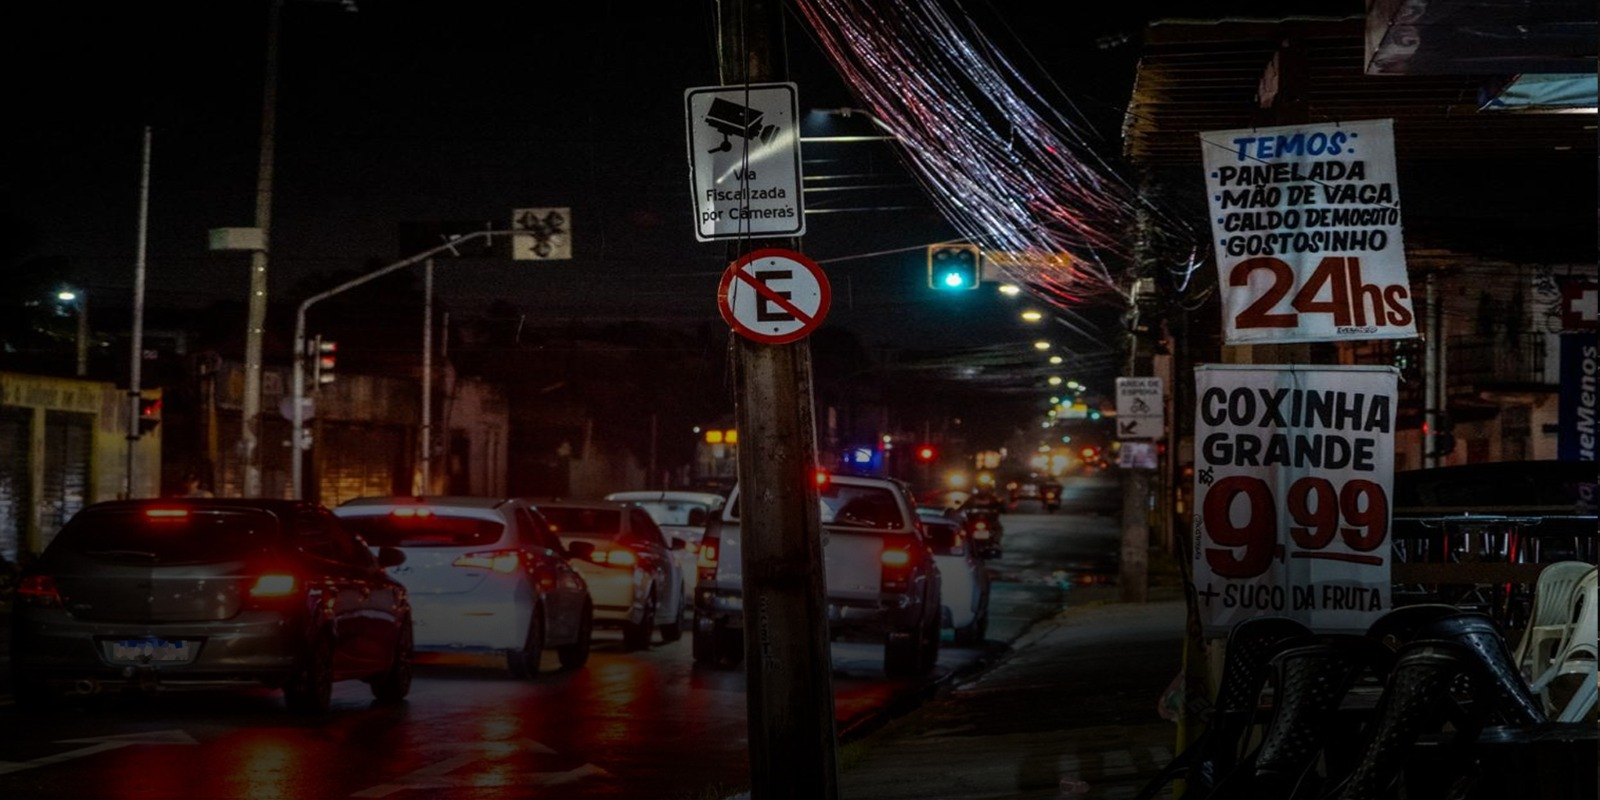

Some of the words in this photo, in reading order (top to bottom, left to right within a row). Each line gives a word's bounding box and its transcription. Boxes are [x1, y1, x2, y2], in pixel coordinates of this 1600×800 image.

[1234, 131, 1357, 161] TEMOS:
[733, 168, 756, 181] Via
[1219, 161, 1365, 186] PANELADA
[706, 187, 786, 202] Fiscalizada
[1221, 183, 1281, 209] MÃO
[1288, 185, 1315, 205] DE
[1323, 184, 1392, 204] VACA
[702, 210, 723, 224] por
[729, 206, 794, 220] Câmeras
[1224, 209, 1299, 232] CALDO
[1227, 230, 1387, 256] GOSTOSINHO
[755, 270, 795, 322] E
[1230, 257, 1412, 329] 24hs
[1201, 387, 1390, 433] COXINHA
[1202, 432, 1375, 471] GRANDE
[1223, 584, 1284, 611] SUCO
[1293, 585, 1315, 611] DA
[1323, 585, 1381, 611] FRUTA
